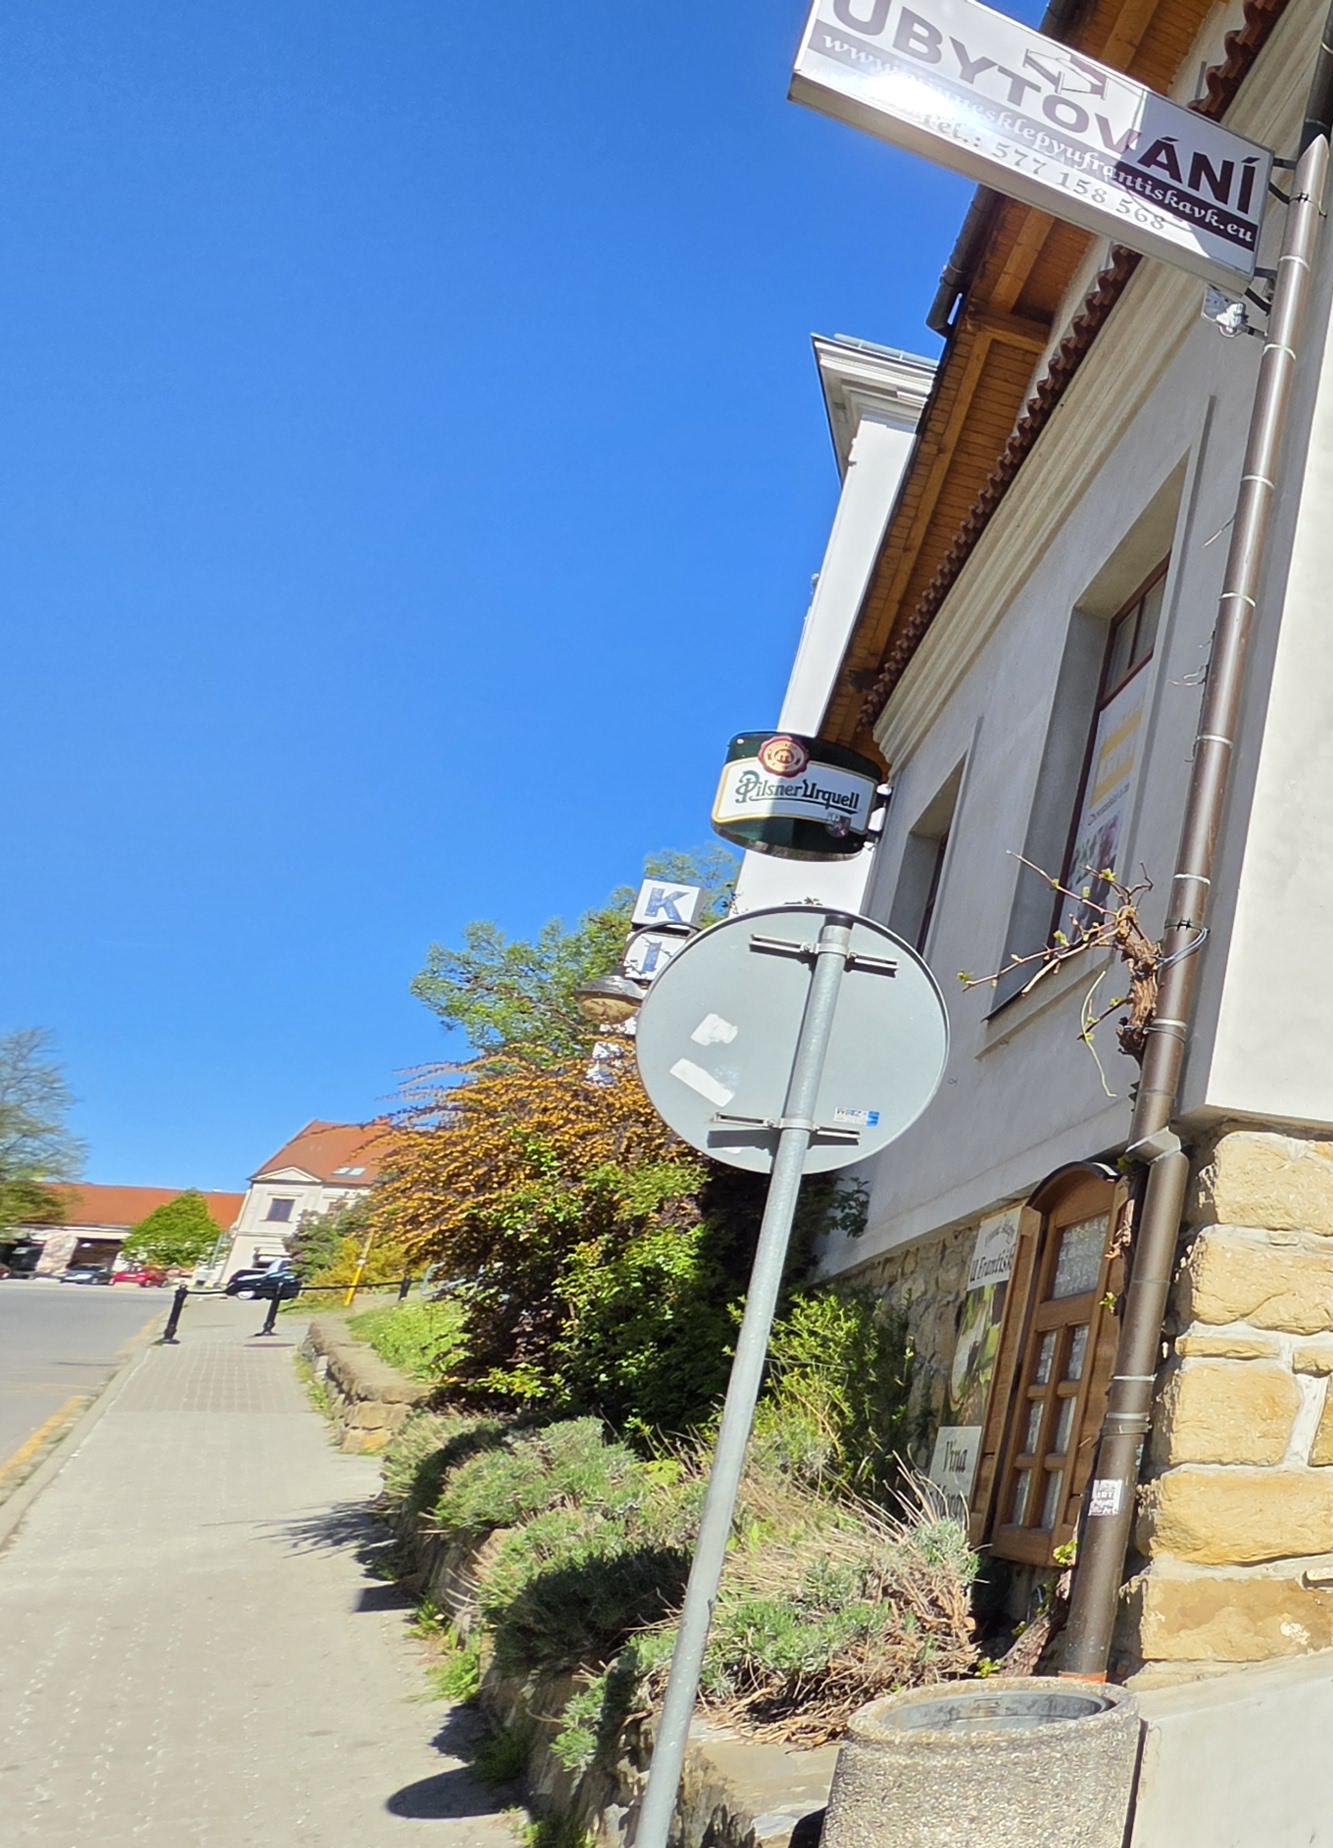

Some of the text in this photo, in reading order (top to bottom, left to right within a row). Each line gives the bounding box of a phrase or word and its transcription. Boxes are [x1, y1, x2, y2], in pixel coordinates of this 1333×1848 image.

[833, 0, 1260, 214] UBYTOVÁNÍ
[991, 143, 1047, 175] 577
[1058, 171, 1107, 203] 158
[1115, 196, 1165, 231] 568
[735, 770, 860, 810] Pilsner Urquell
